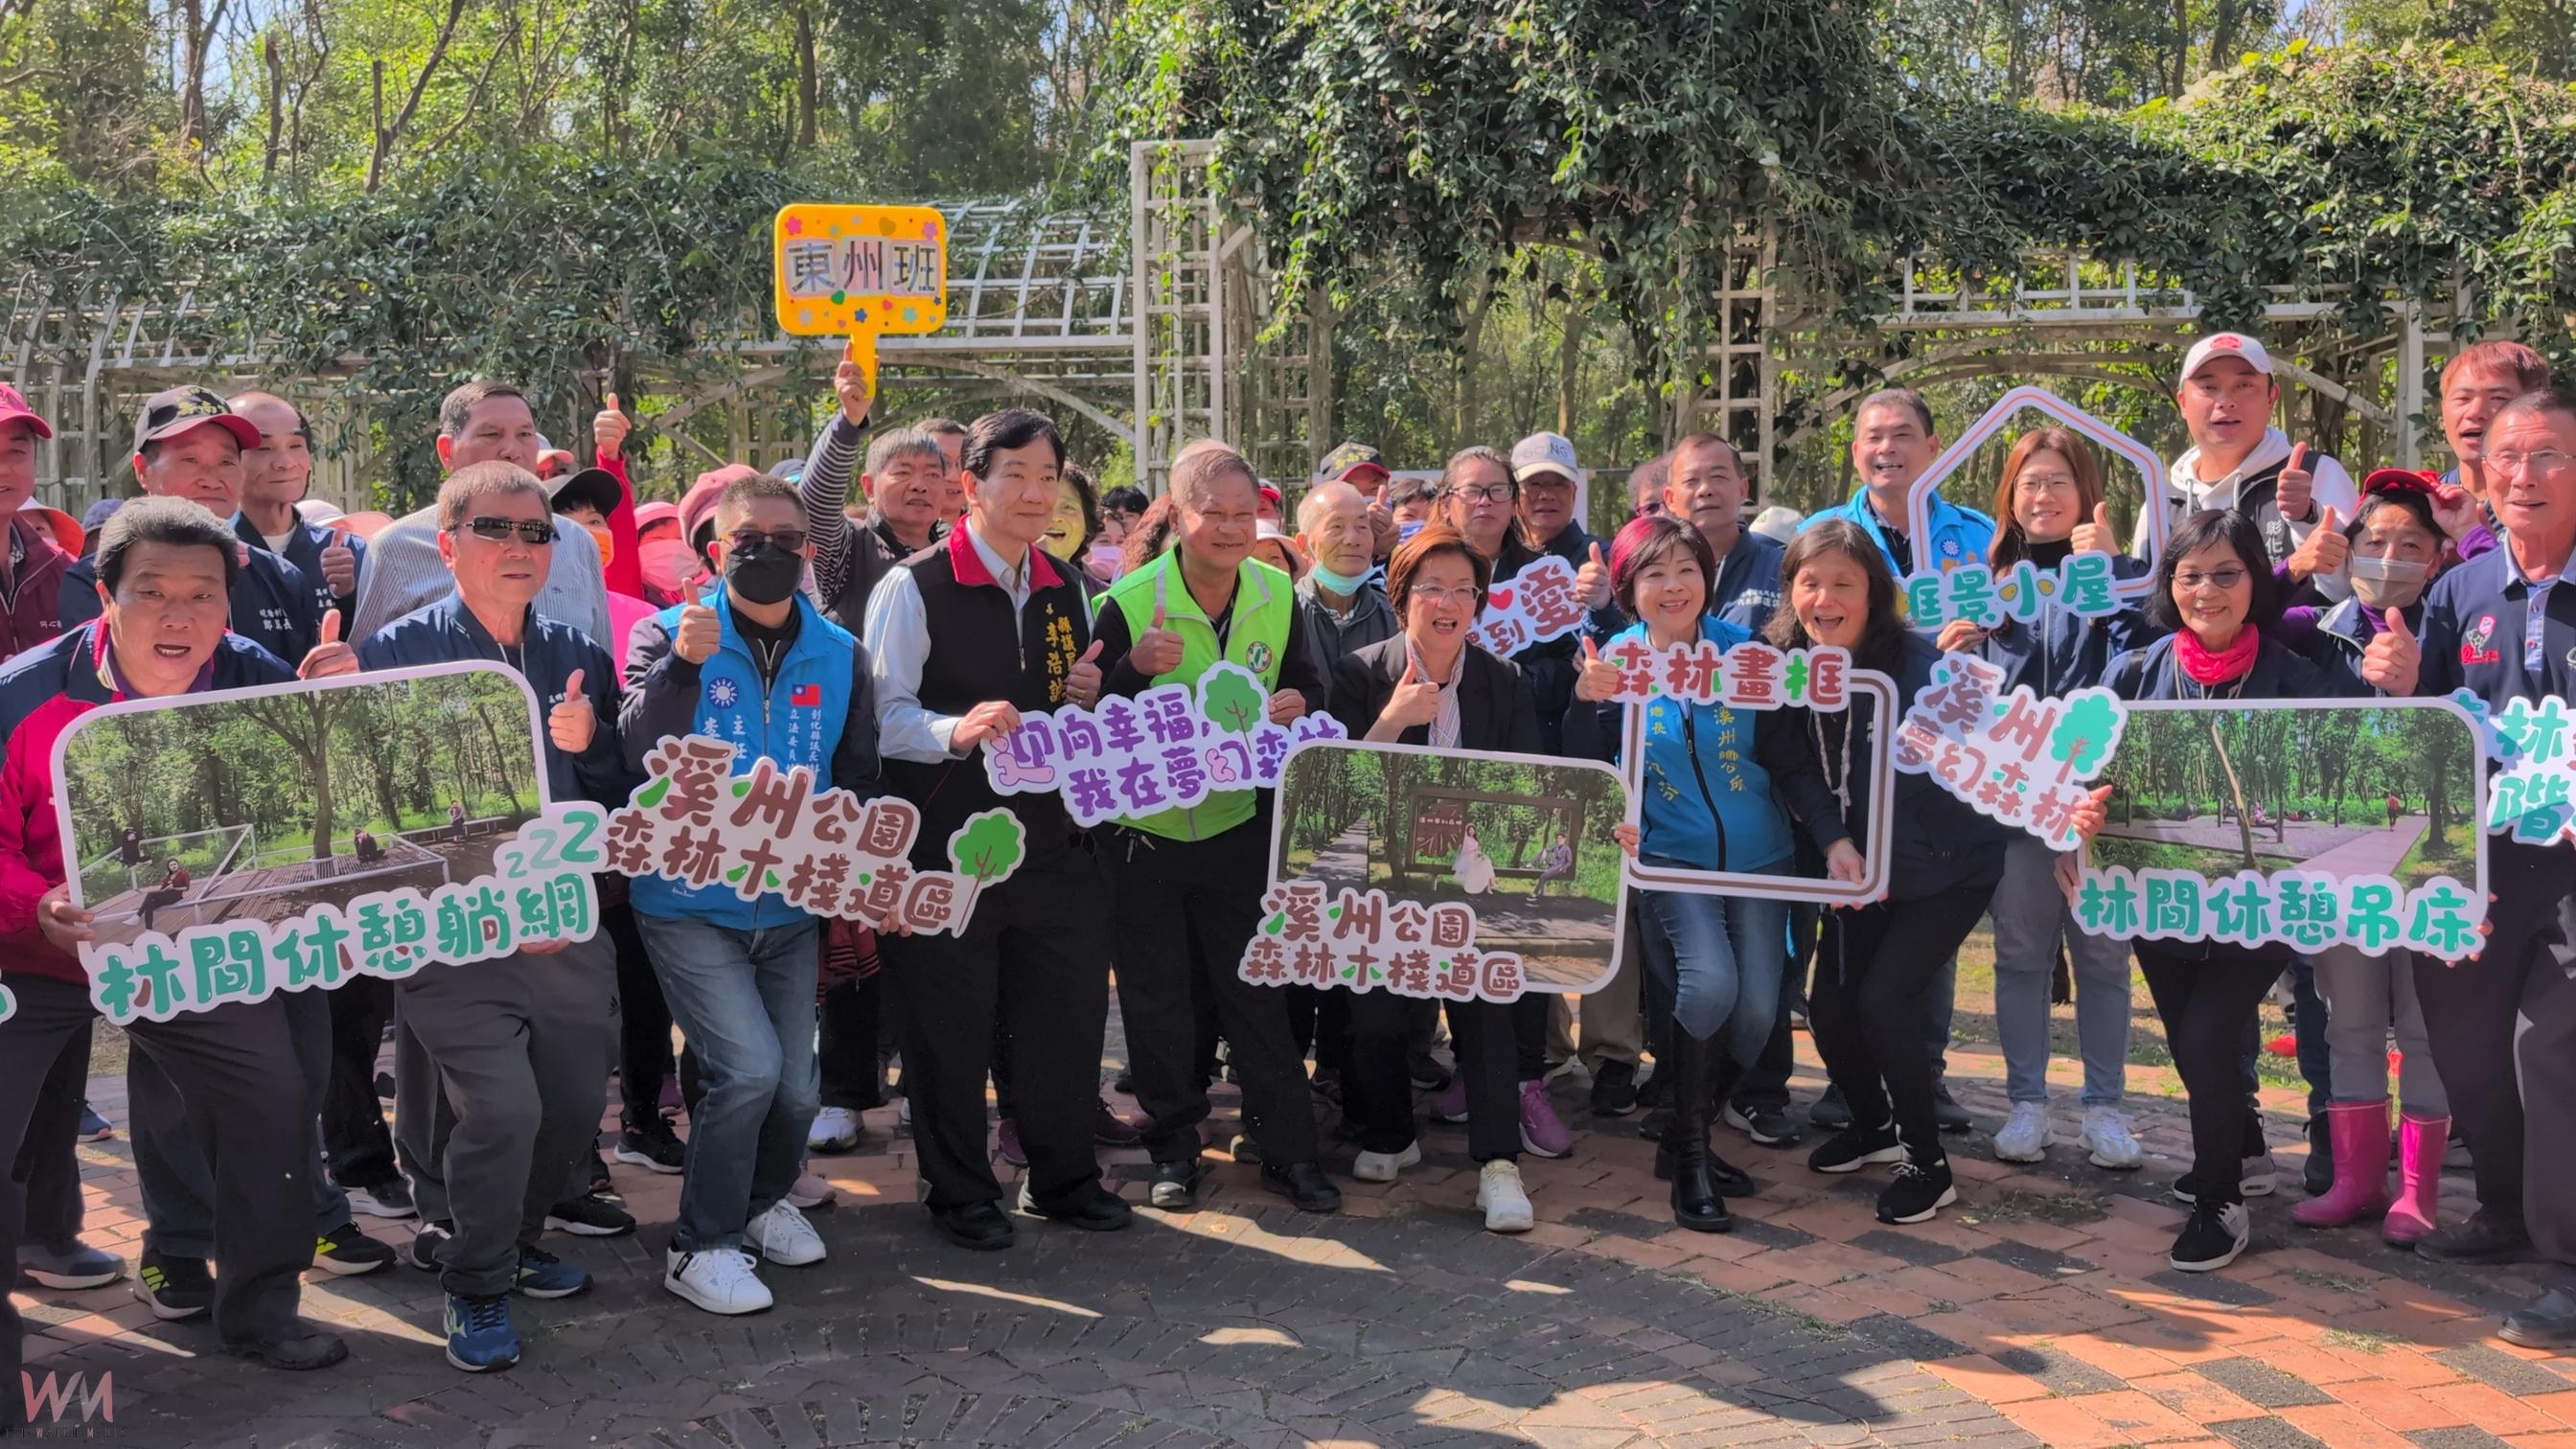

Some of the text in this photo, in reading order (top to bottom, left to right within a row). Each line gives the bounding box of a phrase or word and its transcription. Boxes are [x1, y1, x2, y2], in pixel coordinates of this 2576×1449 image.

[788, 240, 937, 293] 東州班
[1612, 641, 1844, 704] 森林畫框
[1923, 659, 2057, 762] 溪州
[649, 741, 915, 859] 溪州公園
[1896, 713, 2083, 841] 夢幻森林
[607, 810, 955, 929] 森林木棧道區
[2079, 876, 2476, 953] 林間休憩吊床
[98, 872, 589, 1018] 林間休憩躺網
[1267, 886, 1470, 948] 溪州公園
[1245, 938, 1521, 997] 森林木棧道區
